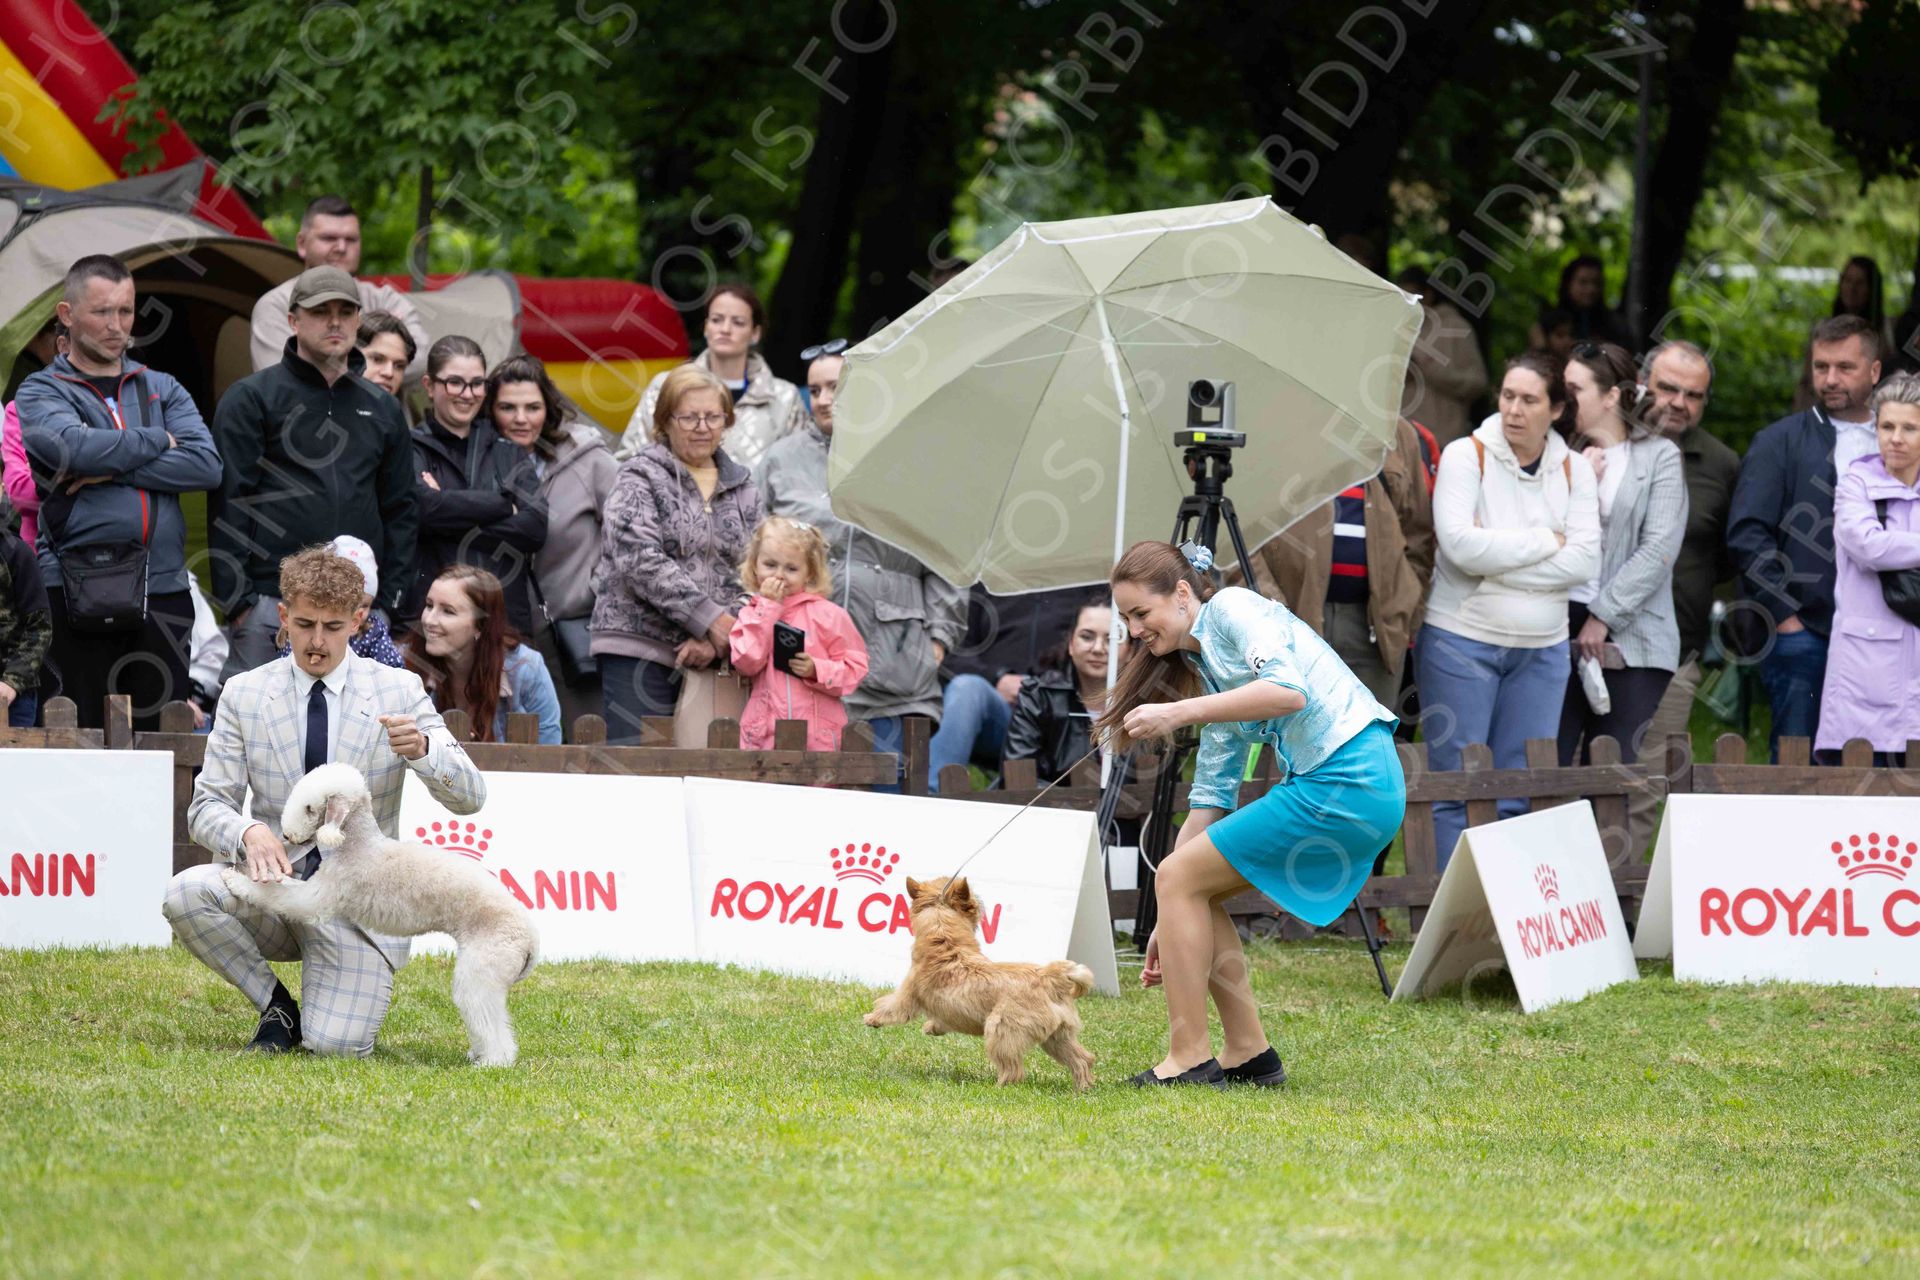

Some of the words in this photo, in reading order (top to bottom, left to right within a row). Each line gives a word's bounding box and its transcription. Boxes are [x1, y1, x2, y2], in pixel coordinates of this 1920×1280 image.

[0, 852, 95, 896] NIN
[710, 878, 844, 930] ROYAL
[857, 892, 1002, 944] CAN
[1517, 911, 1564, 960] ROYAL
[1560, 899, 1607, 947] CANIN
[1701, 887, 1869, 937] ROYAL
